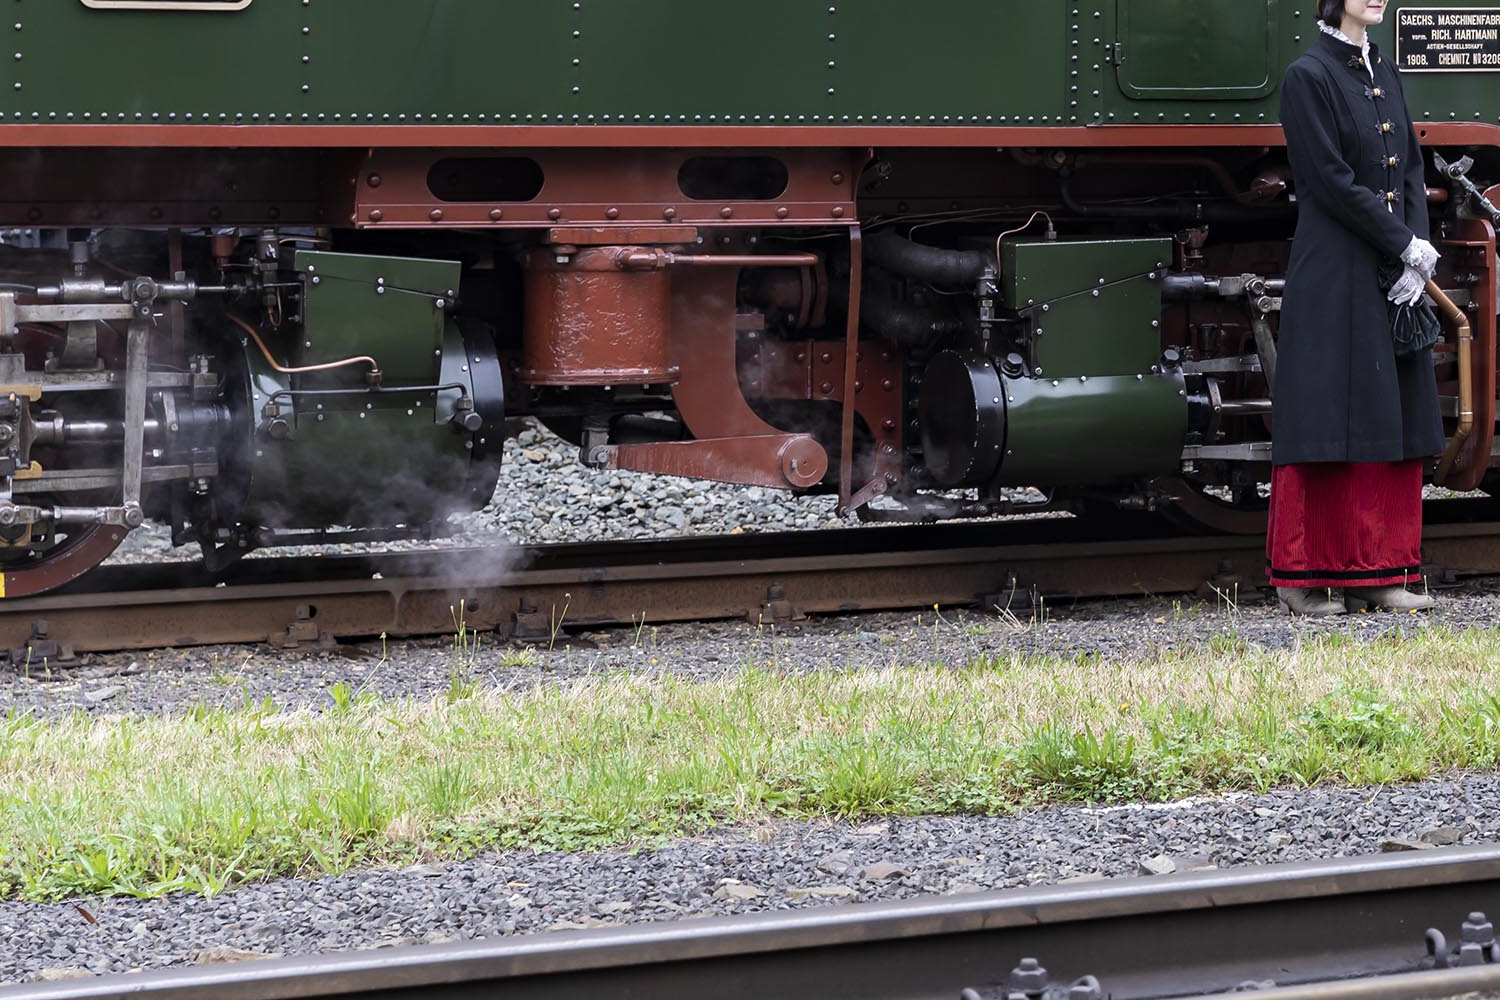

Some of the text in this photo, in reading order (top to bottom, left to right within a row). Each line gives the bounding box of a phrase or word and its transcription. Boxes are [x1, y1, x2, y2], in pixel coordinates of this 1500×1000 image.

[1401, 14, 1435, 26] SAECHS.
[1431, 29, 1452, 40] RICH.
[1455, 29, 1498, 40] HARTMANN
[1406, 54, 1429, 65] 1908.
[1438, 53, 1470, 65] CHEMNITZ
